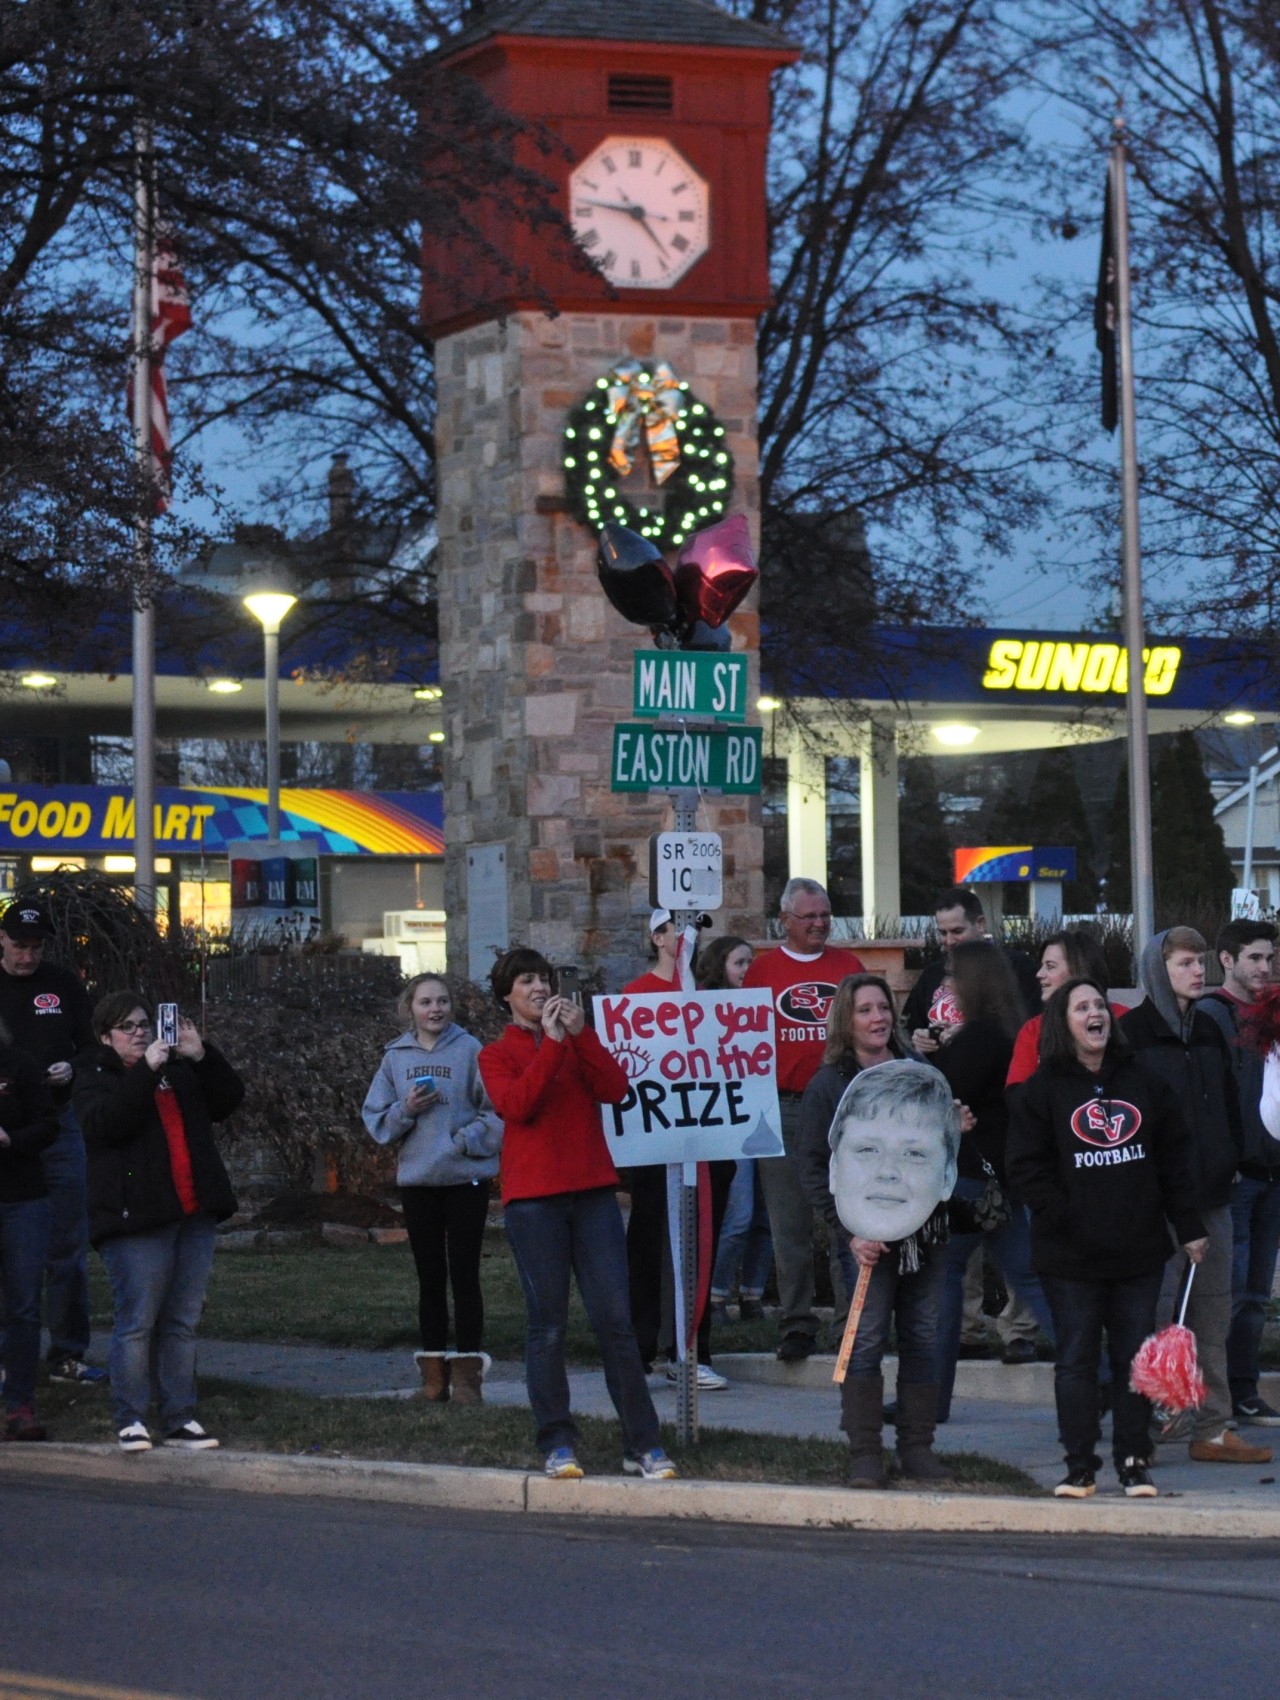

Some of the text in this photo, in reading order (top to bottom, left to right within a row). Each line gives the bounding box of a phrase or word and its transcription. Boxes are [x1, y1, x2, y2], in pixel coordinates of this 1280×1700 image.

[638, 658, 741, 713] MAIN ST
[615, 732, 757, 785] EASTON RD
[662, 843, 685, 860] SR
[602, 997, 704, 1045] Keep
[406, 1065, 453, 1081] LEHIGH
[659, 1042, 774, 1081] on the
[612, 1080, 750, 1137] PRIZE
[1074, 1144, 1146, 1168] FOOTBALL
